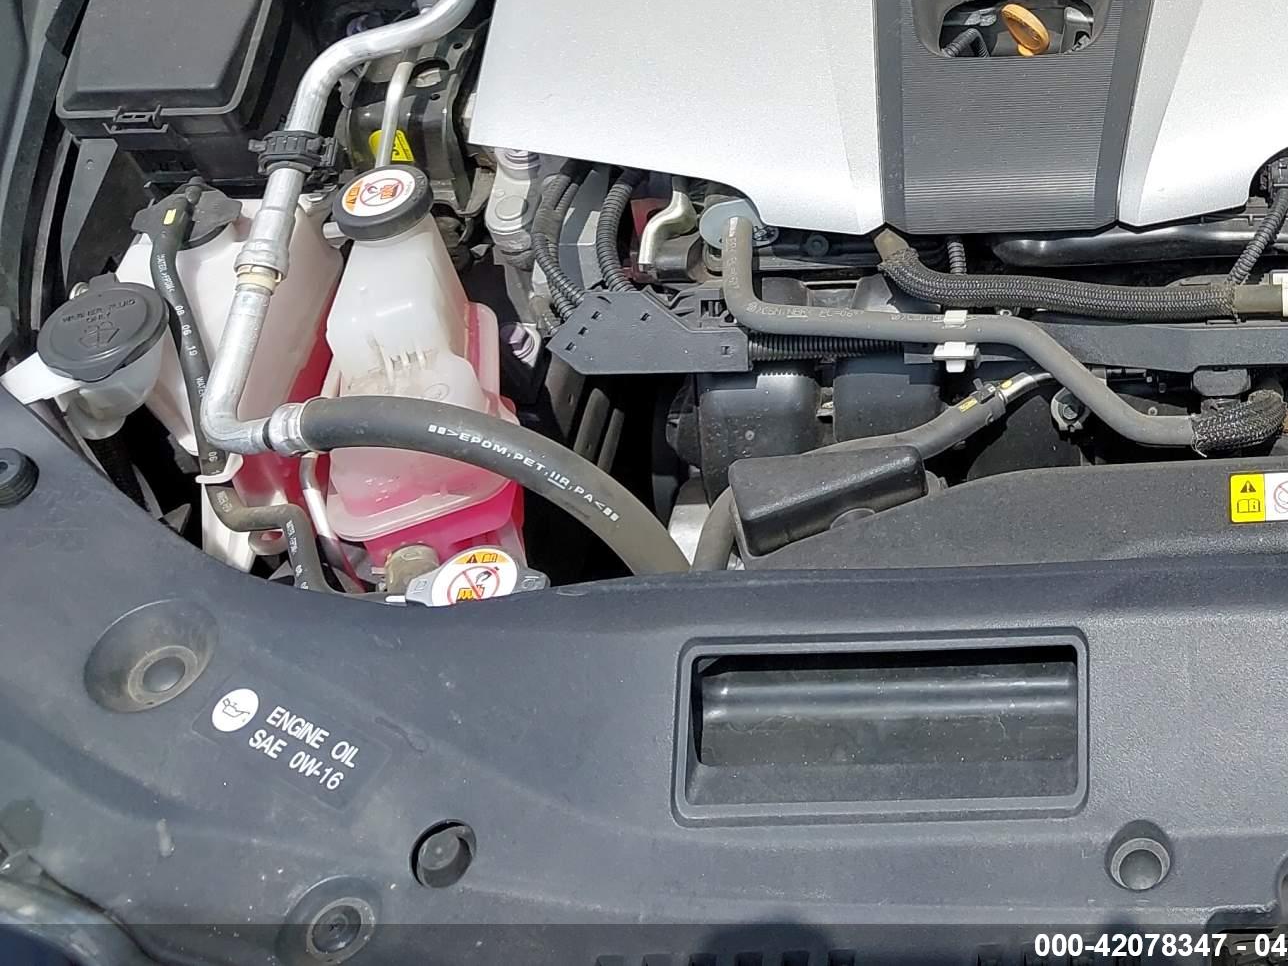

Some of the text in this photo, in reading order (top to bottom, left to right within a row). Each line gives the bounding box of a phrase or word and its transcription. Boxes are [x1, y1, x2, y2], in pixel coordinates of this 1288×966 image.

[249, 729, 344, 790] SAE 0W-16
[266, 706, 359, 768] ENGINE OIL
